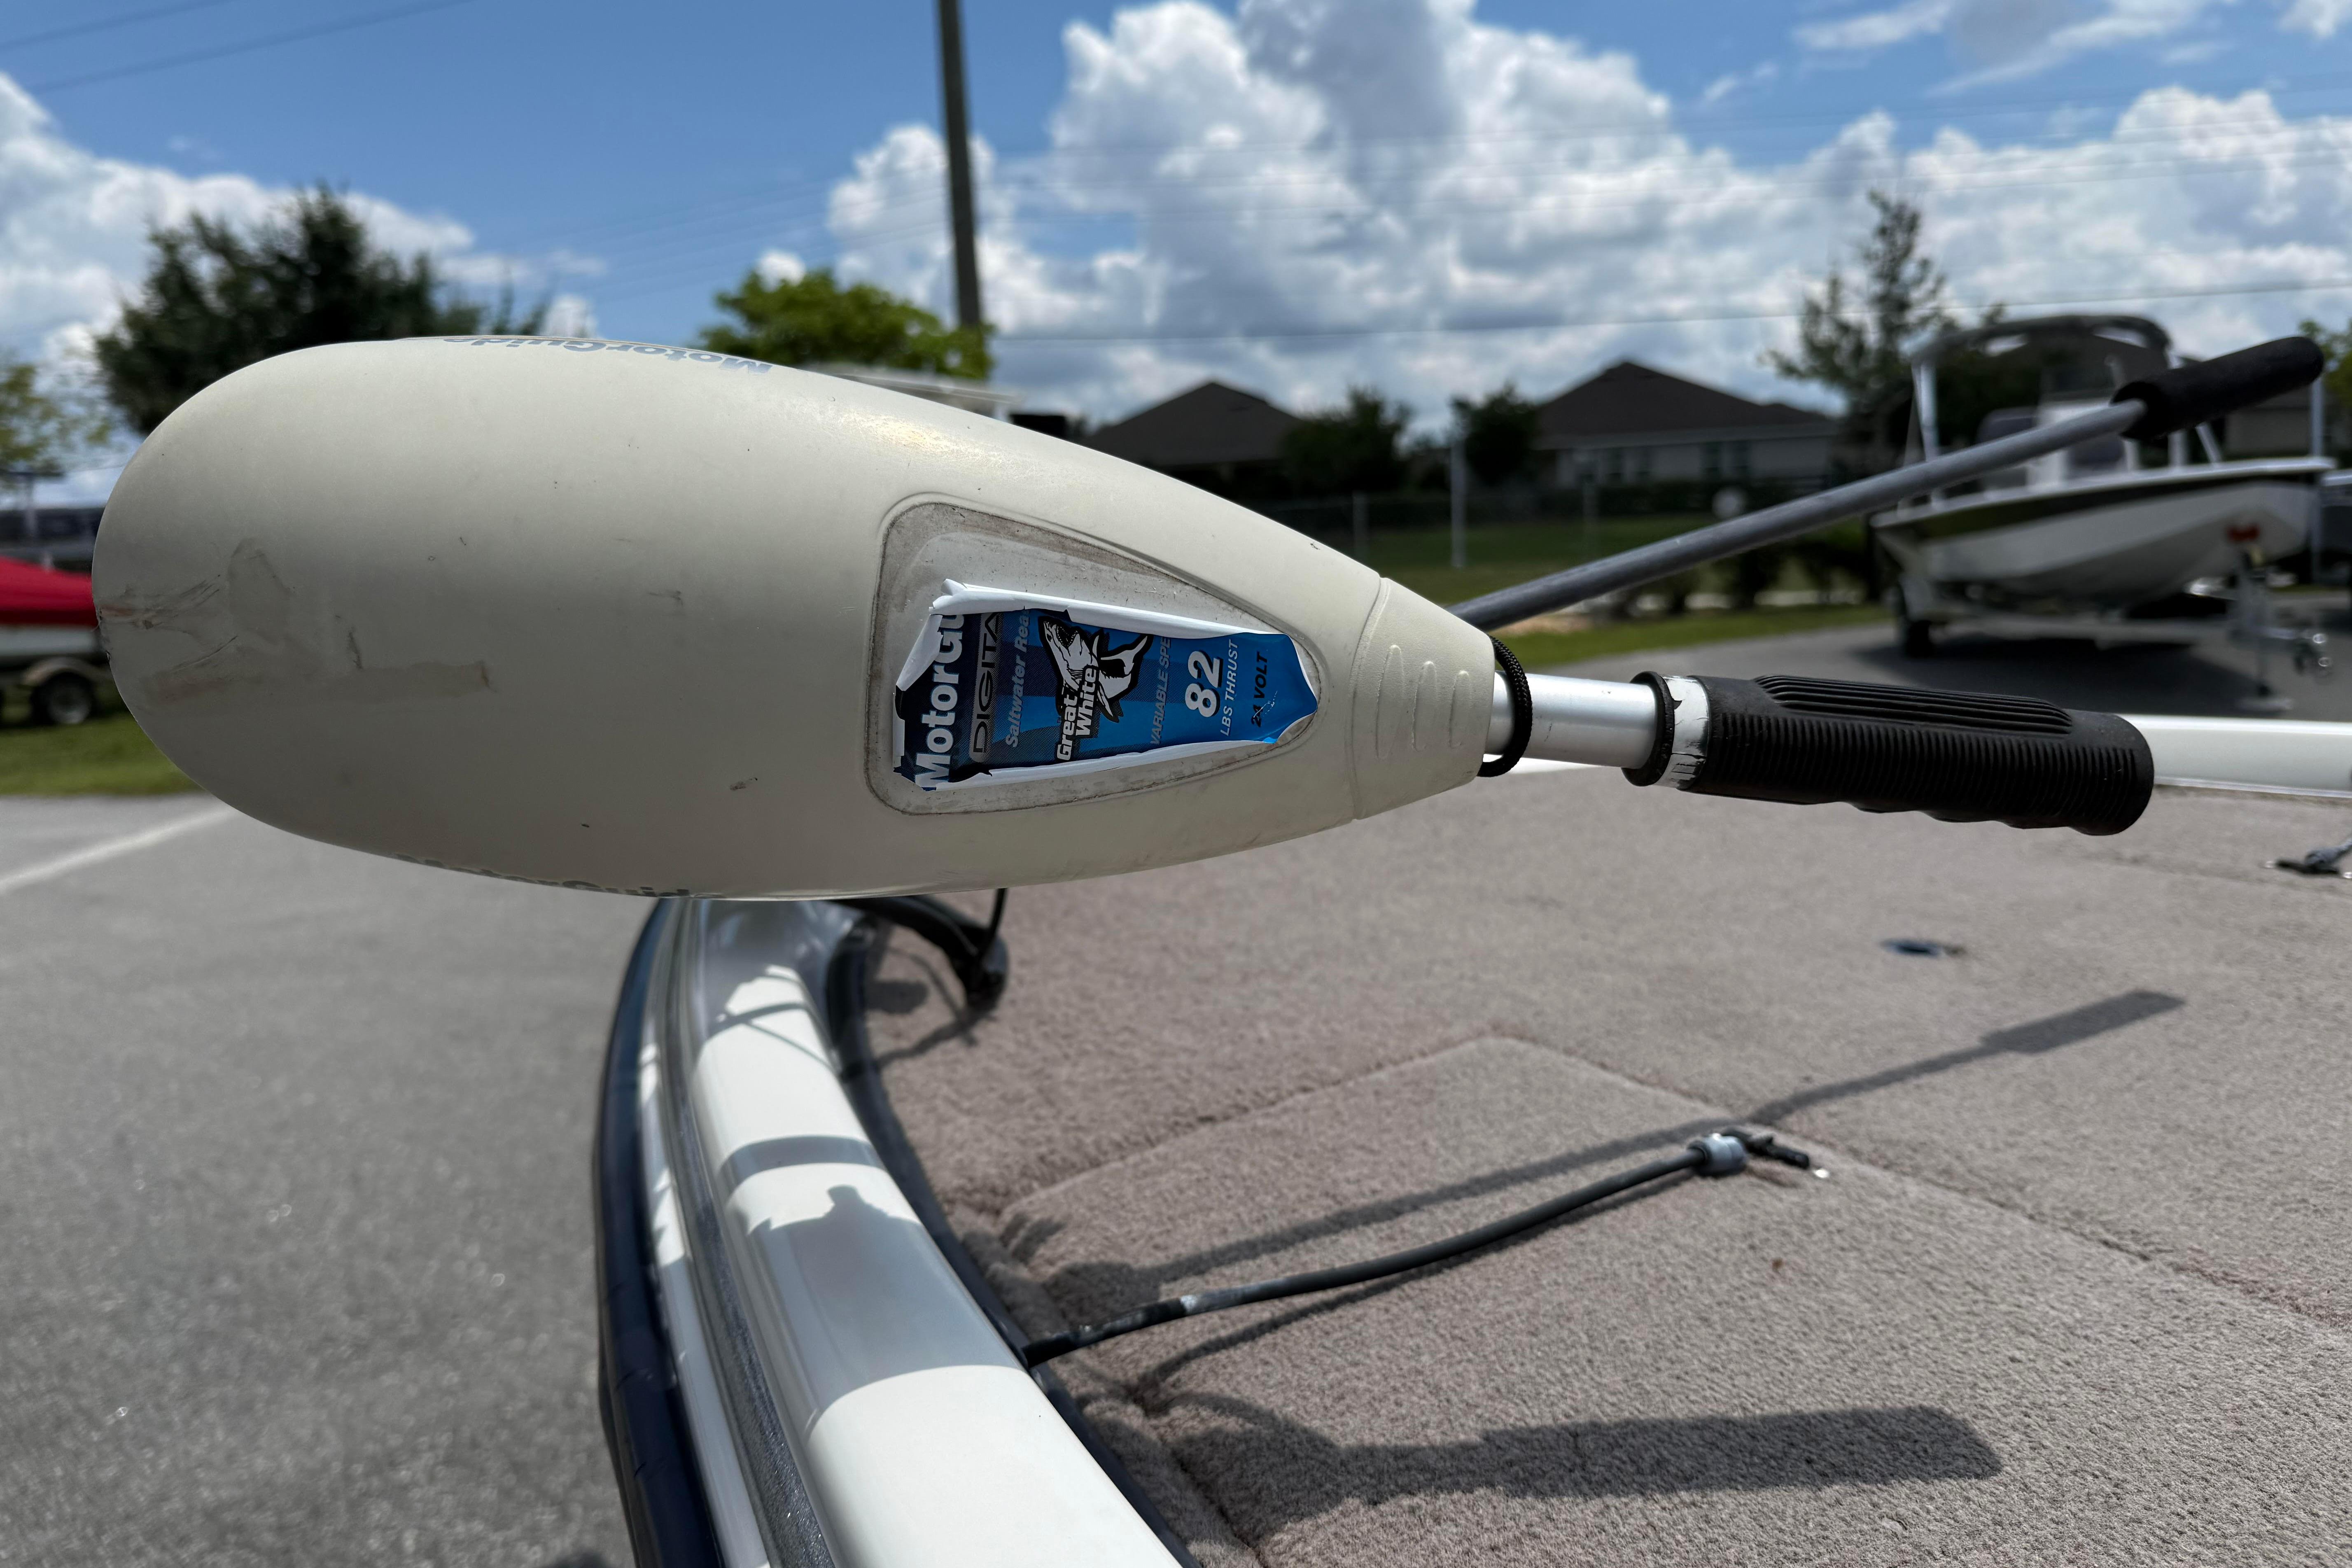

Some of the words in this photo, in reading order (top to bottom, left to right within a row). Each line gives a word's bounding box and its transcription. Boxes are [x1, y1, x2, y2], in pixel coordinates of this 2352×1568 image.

[1015, 609, 1030, 652] Rea
[1005, 655, 1027, 747] Saltwater
[1075, 667, 1096, 736] White
[1184, 651, 1222, 718] 82
[1225, 639, 1239, 701] THRUST
[1254, 651, 1268, 699] VOLT
[1056, 694, 1078, 761] Great
[1150, 668, 1168, 745] VARIABLE
[1220, 705, 1233, 736] LBS
[1251, 705, 1263, 727] 24
